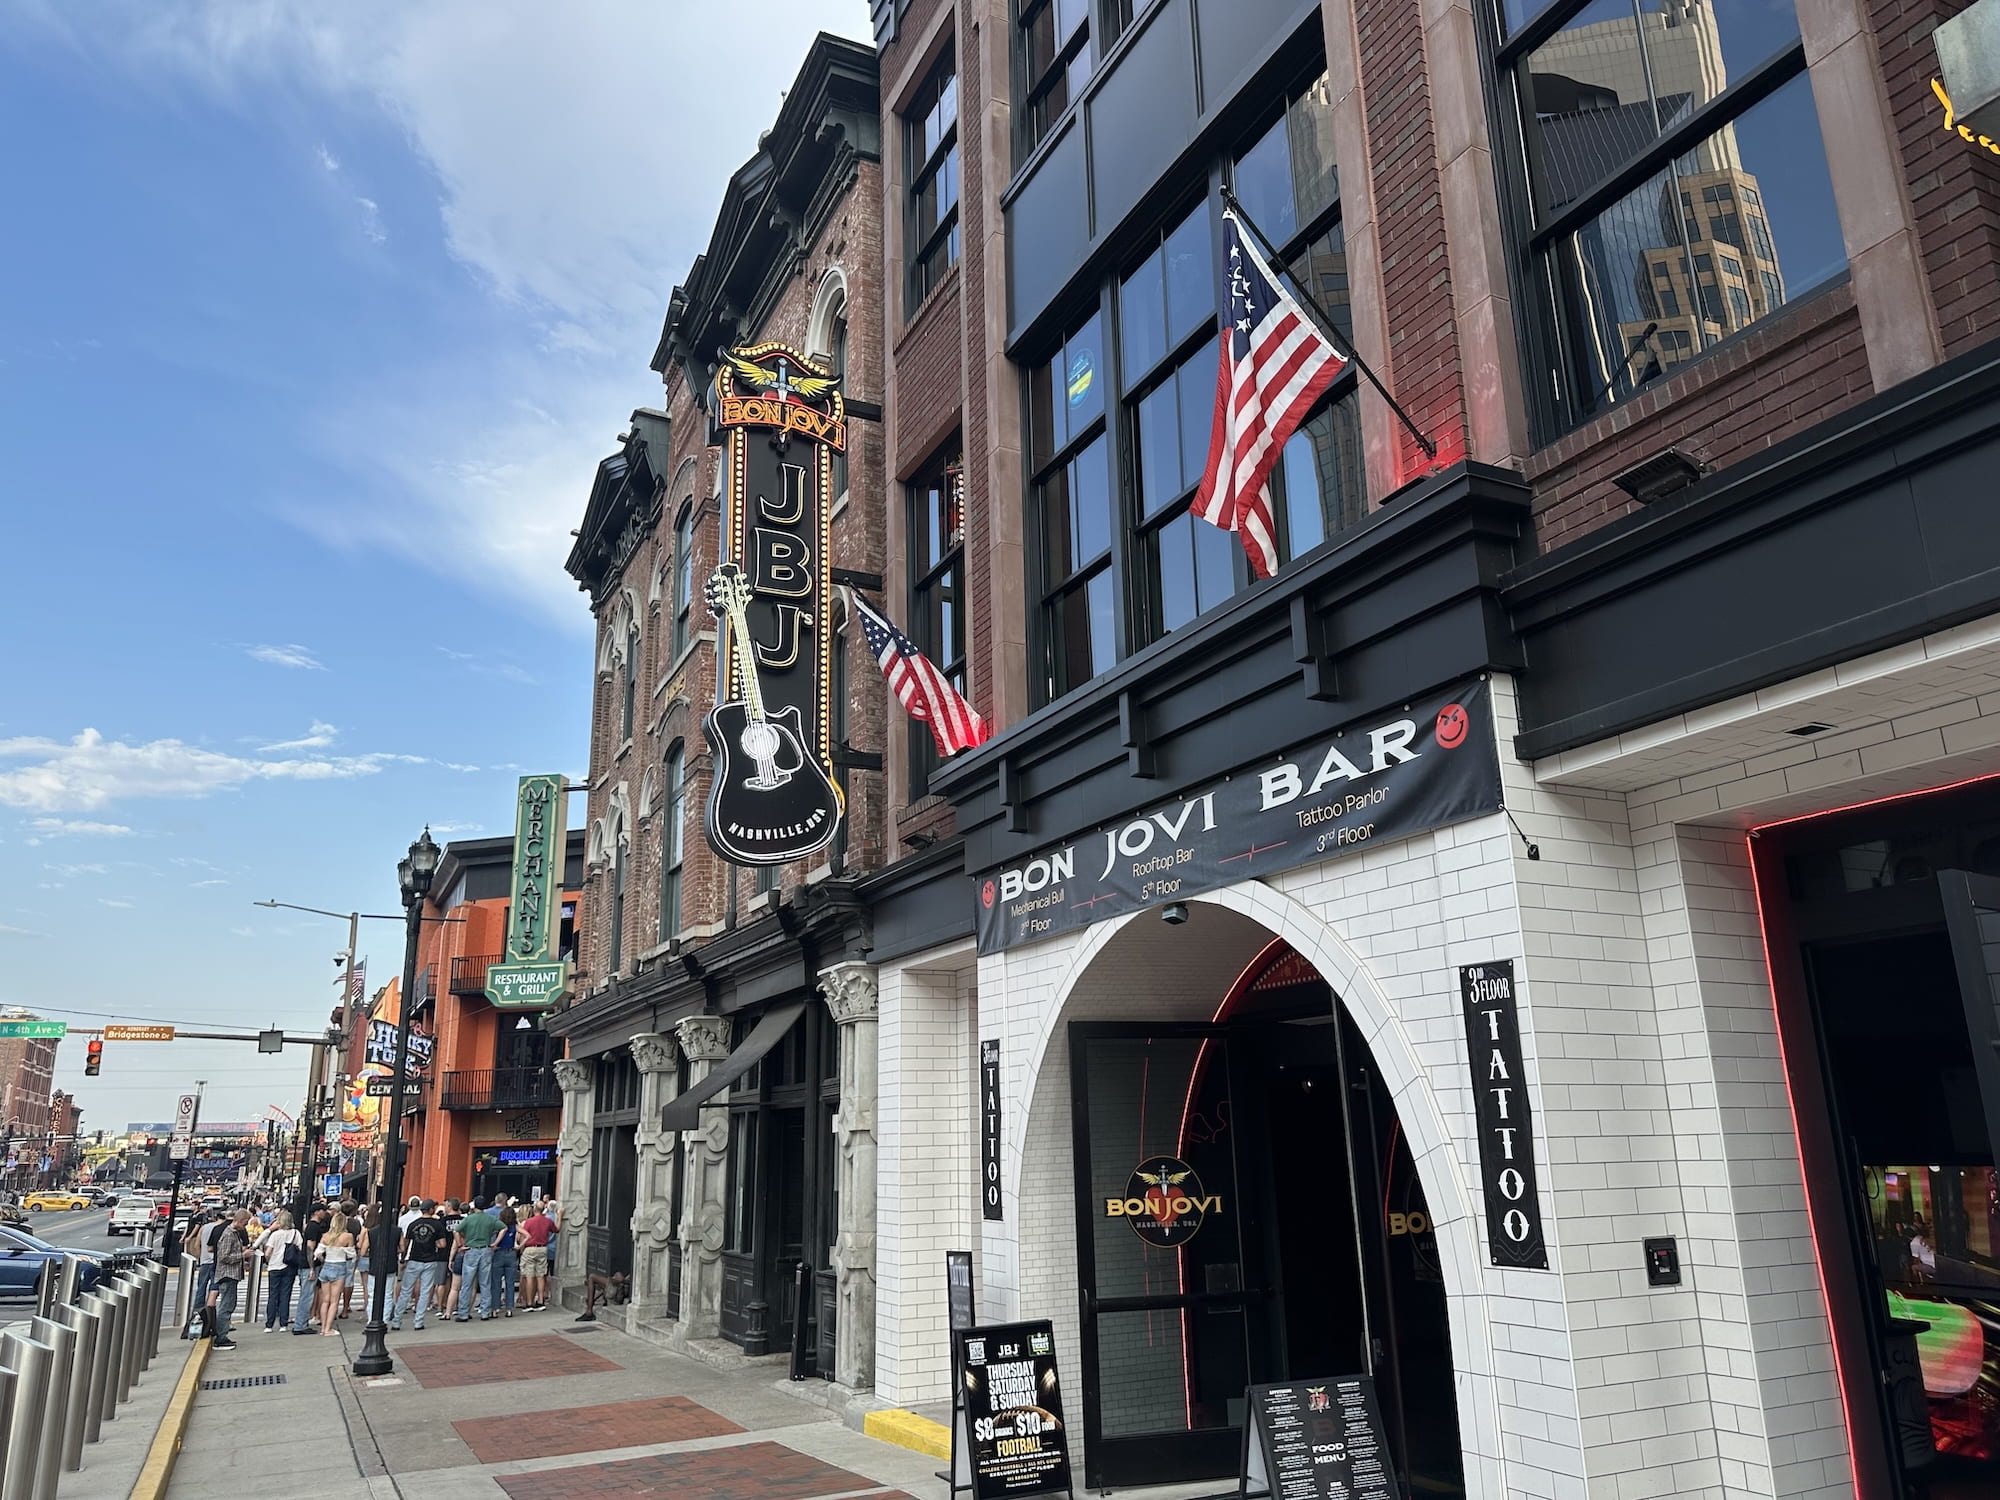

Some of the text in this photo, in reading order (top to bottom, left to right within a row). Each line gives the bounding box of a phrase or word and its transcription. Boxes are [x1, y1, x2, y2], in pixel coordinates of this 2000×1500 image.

[724, 400, 843, 446] BON JOVI
[1000, 718, 1422, 903] BON JOVI BAR
[1296, 787, 1390, 828] Tattoo Parlor
[1316, 823, 1375, 852] 3rd Floor
[519, 784, 548, 954] MERCHANTS
[1132, 848, 1194, 878] Rooftop Bar
[1051, 888, 1065, 905] Bull
[1141, 878, 1181, 900] 5th Floor
[1031, 918, 1052, 933] Floor
[494, 971, 558, 985] RESTAURANT
[1480, 977, 1510, 1001] FLOOR
[502, 983, 547, 996] & GRILL
[107, 1030, 170, 1040] Bridgestone Dr
[368, 1040, 416, 1072] TOK
[369, 1084, 420, 1095] CENAL
[986, 1067, 998, 1206] TATTOO
[1481, 1009, 1530, 1242] TATTOO
[501, 1150, 549, 1160] BUSCH LIGHT
[1106, 1196, 1222, 1221] BON JOVI
[986, 1360, 1034, 1380] THURSDAY
[989, 1376, 1035, 1395] SATURDAY
[990, 1390, 1037, 1411] & SUNDAY
[974, 1417, 994, 1442] $8
[1016, 1411, 1056, 1436] $10 FOOD
[997, 1436, 1043, 1457] FOOTBALL
[1312, 1442, 1344, 1453] FOOD
[1314, 1453, 1346, 1465] MENU
